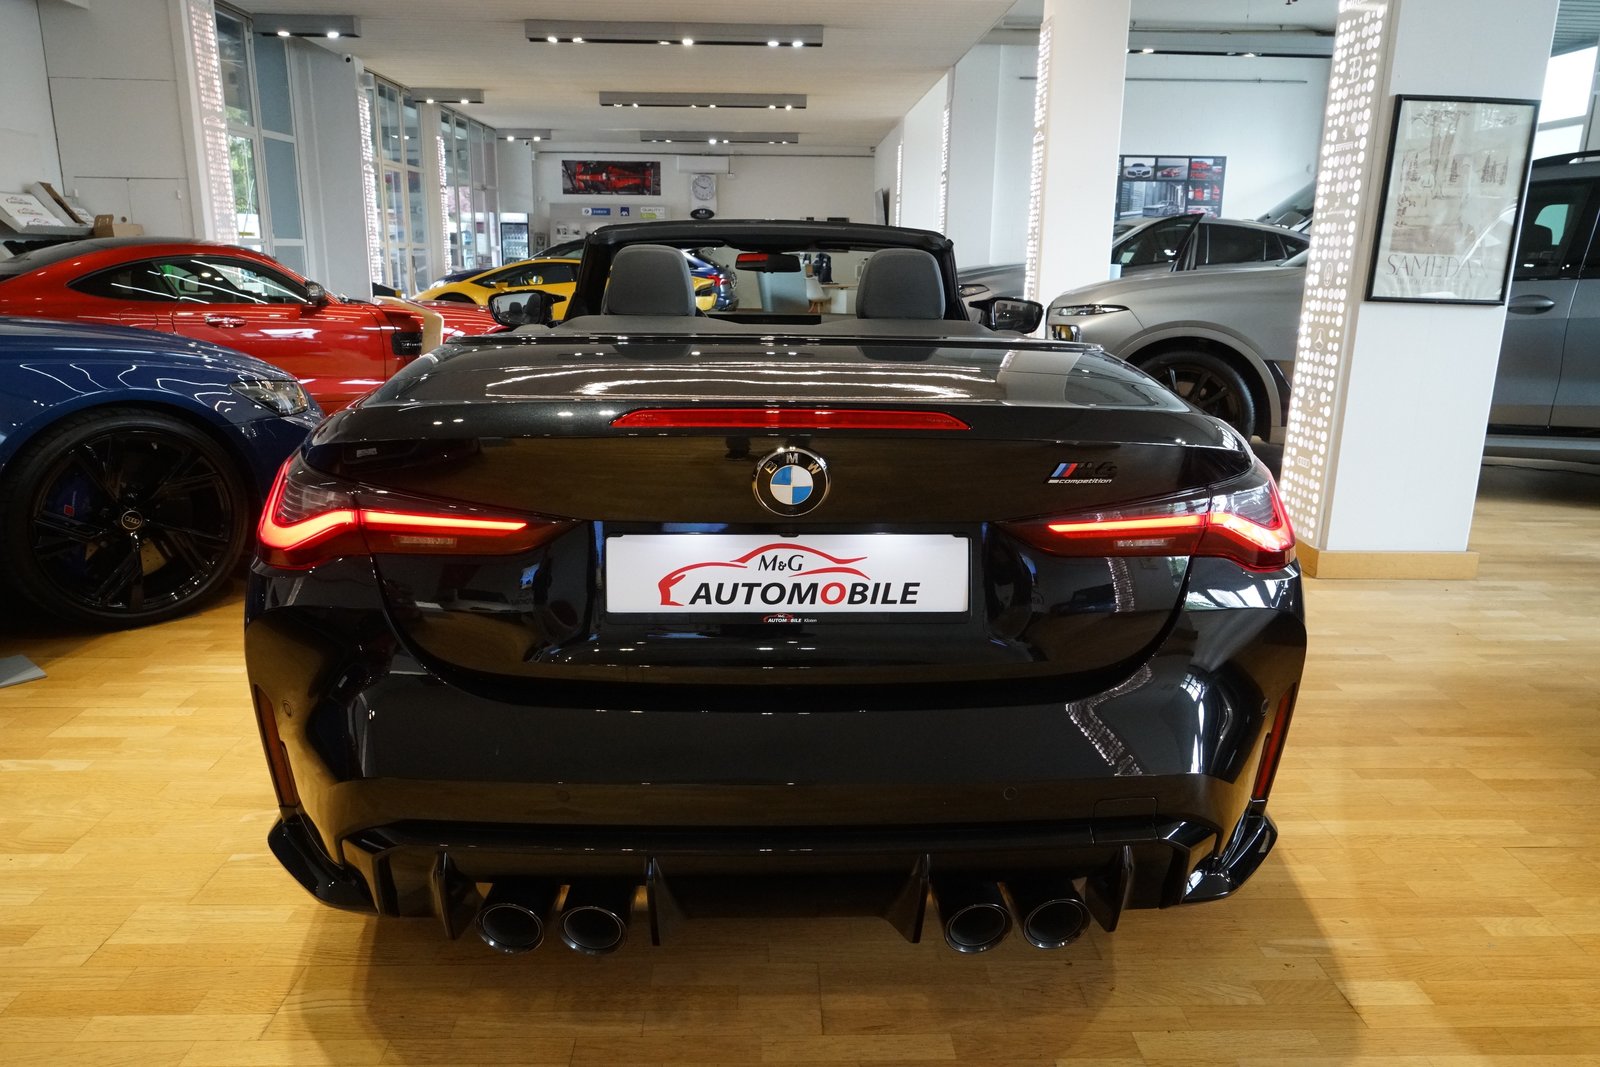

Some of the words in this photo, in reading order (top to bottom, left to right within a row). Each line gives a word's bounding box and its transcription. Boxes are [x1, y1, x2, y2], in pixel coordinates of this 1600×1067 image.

[764, 453, 822, 475] BMW
[758, 554, 804, 571] M&G
[689, 582, 920, 605] AUTOMOBILE
